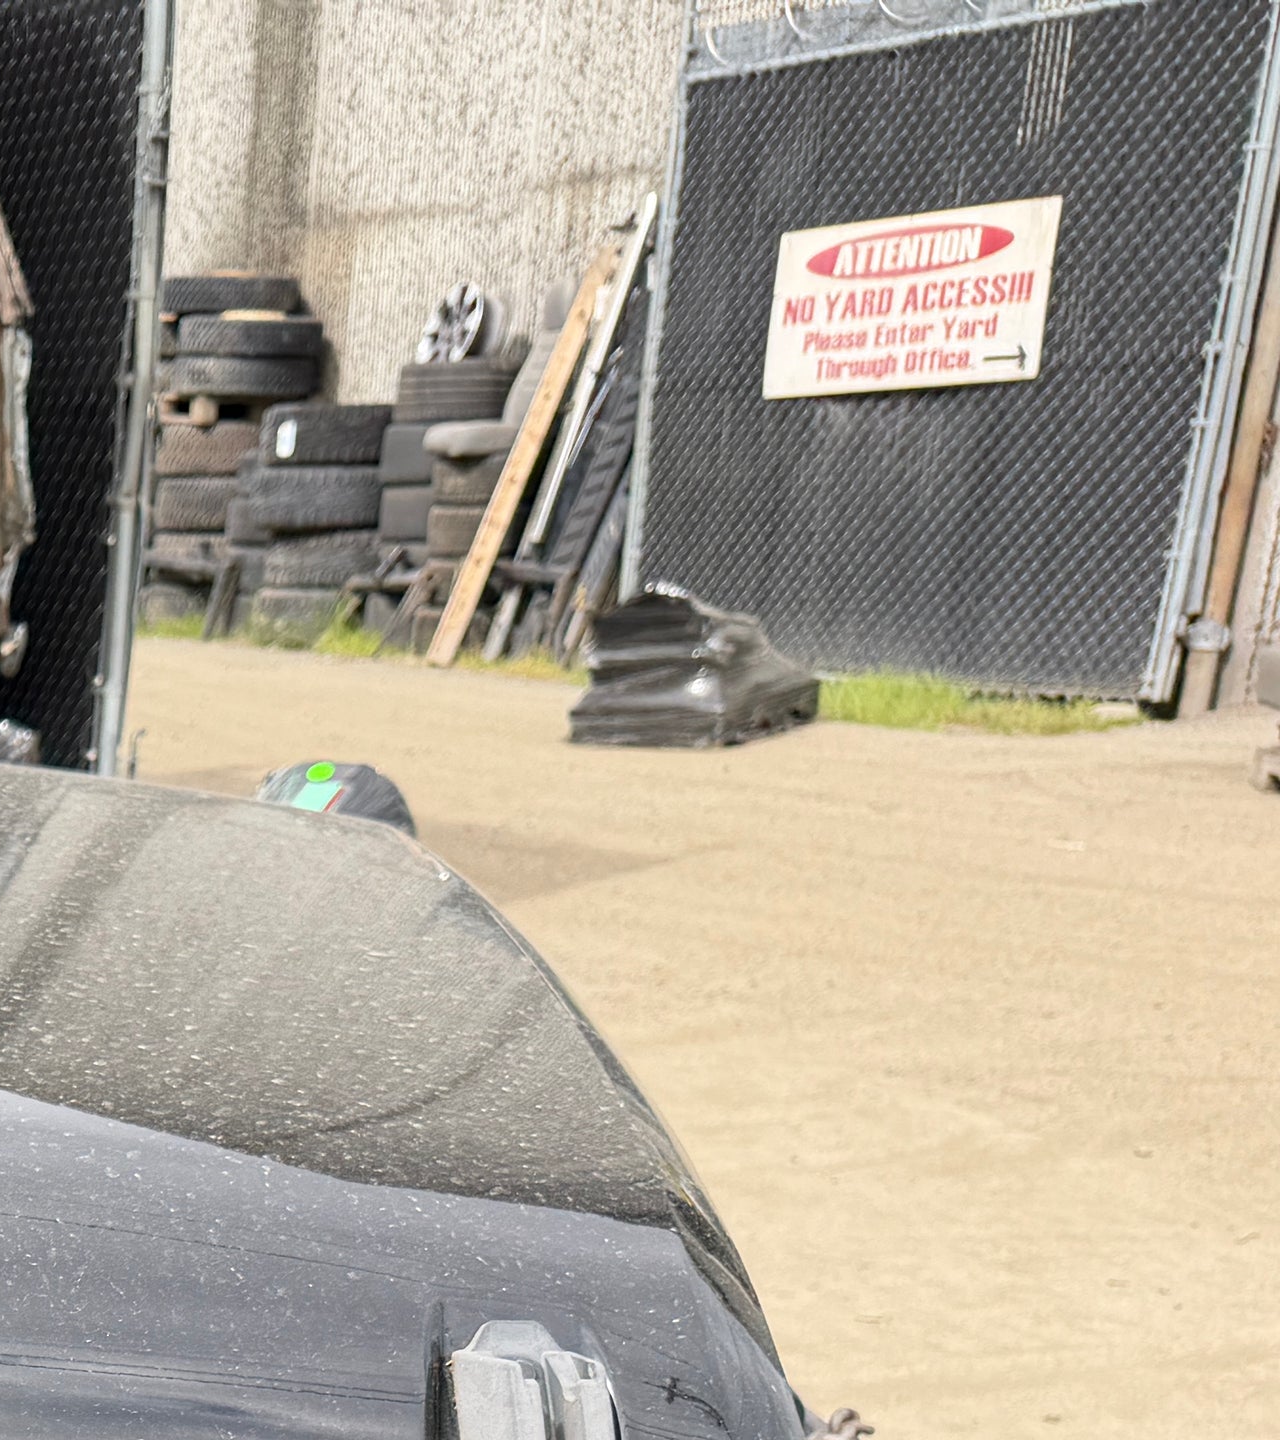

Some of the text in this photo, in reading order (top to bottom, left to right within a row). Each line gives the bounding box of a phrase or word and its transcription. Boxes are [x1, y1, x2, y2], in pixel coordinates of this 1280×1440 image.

[832, 227, 982, 276] ATTENTION
[782, 270, 1036, 327] NO YARD ACCESS!!!
[802, 312, 1000, 354] Please Enter Yard
[816, 356, 897, 382] Through
